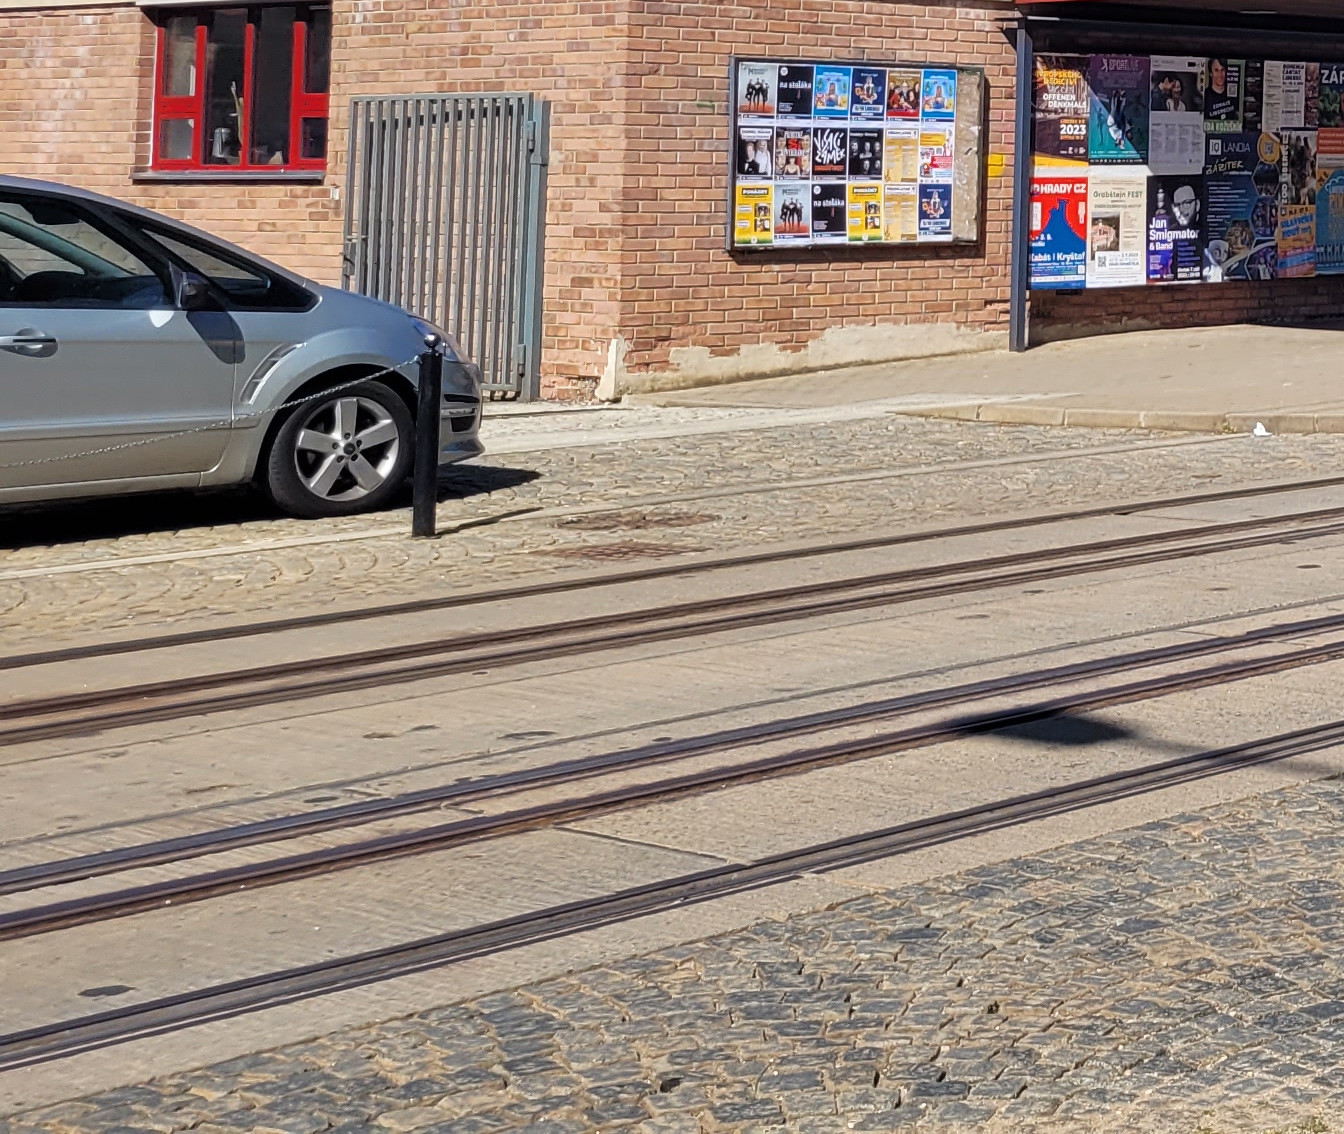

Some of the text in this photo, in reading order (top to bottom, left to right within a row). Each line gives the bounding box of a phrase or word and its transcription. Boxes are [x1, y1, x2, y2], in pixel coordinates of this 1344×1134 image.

[1042, 93, 1076, 101] OFFENEN
[1060, 124, 1087, 135] 2023
[1041, 183, 1087, 194] HRADY CZ
[1149, 217, 1166, 229] Jan
[1149, 228, 1200, 242] Smigmator
[1155, 241, 1173, 250] Band
[1056, 252, 1086, 262] Kryštof
